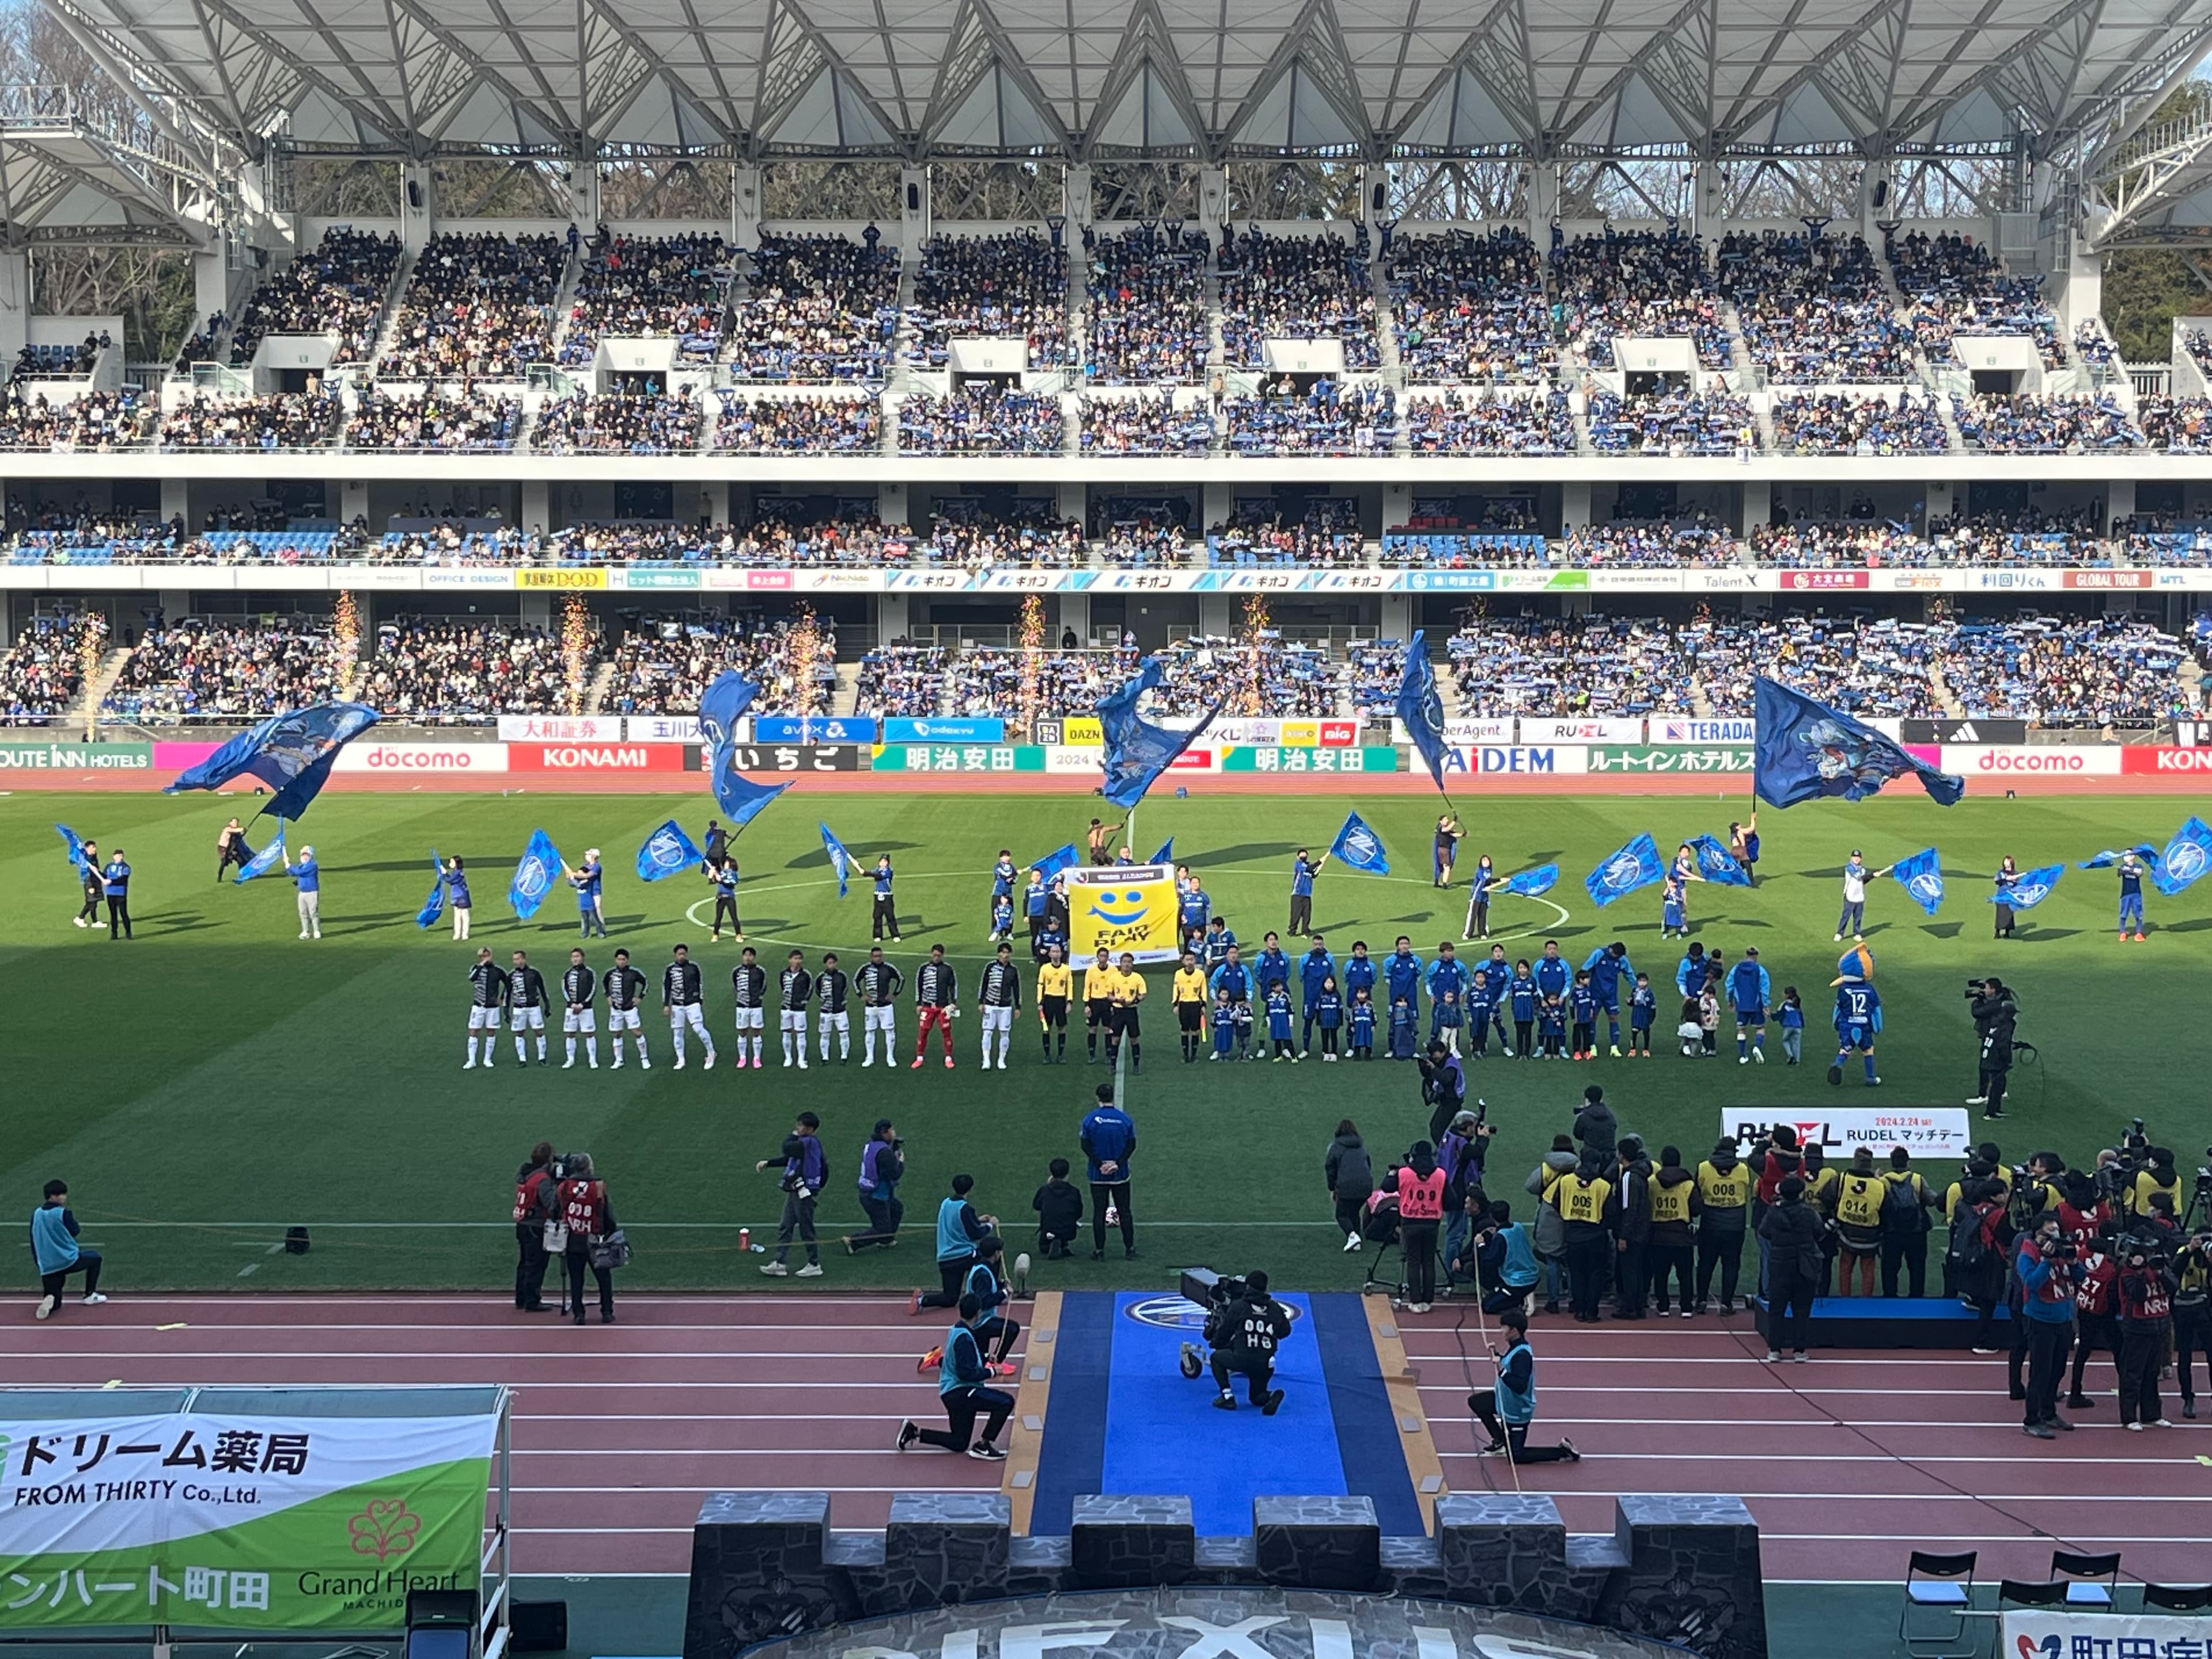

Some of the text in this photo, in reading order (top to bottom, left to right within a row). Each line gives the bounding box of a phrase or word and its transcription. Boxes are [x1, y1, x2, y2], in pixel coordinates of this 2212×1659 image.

[429, 575, 508, 584] OFFICE DESIGN
[556, 572, 598, 587] DOD
[923, 575, 956, 587] ギオン
[1016, 575, 1048, 587] ギオン
[1135, 575, 1172, 588] ギオン
[1257, 575, 1289, 587] ギオン
[1349, 575, 1381, 587] ギオン
[1981, 573, 2046, 587] 利回りくん
[2076, 574, 2140, 587] GLOBAL TOUR
[523, 721, 597, 738] 大和証券
[653, 721, 704, 738] 玉川大
[1070, 729, 1100, 739] DAZN
[1691, 722, 1754, 741] TERADA
[0, 750, 47, 768] OUTE
[90, 755, 147, 767] HOTELS
[367, 746, 471, 767] docomo
[543, 748, 647, 767] KONAMI
[734, 747, 839, 771] いちご
[907, 747, 1014, 771] 明治安田
[1056, 755, 1089, 765] 2024
[1255, 747, 1363, 771] 明治安田
[1979, 749, 2084, 771] docomo
[2157, 750, 2212, 770] KON
[1851, 993, 1866, 1014] 12
[1876, 1117, 1919, 1126] 2024.2.24
[1847, 1129, 1964, 1141] RUDEL マッチデー
[1409, 1190, 1436, 1202] 109
[1713, 1184, 1735, 1196] 008
[1572, 1195, 1592, 1208] 006
[1656, 1196, 1677, 1209] 010
[1846, 1200, 1868, 1214] 014
[2081, 1276, 2101, 1294] 27
[2076, 1291, 2096, 1310] RH
[21, 1430, 309, 1476] ドリーム薬局
[14, 1479, 262, 1506] FROM THIRTY Co.,Ltd.
[7, 1565, 269, 1611] ンハート町田
[298, 1569, 460, 1596] Grand Heart
[343, 1599, 404, 1611] MACHID
[2071, 1636, 2212, 1659] 町田病
